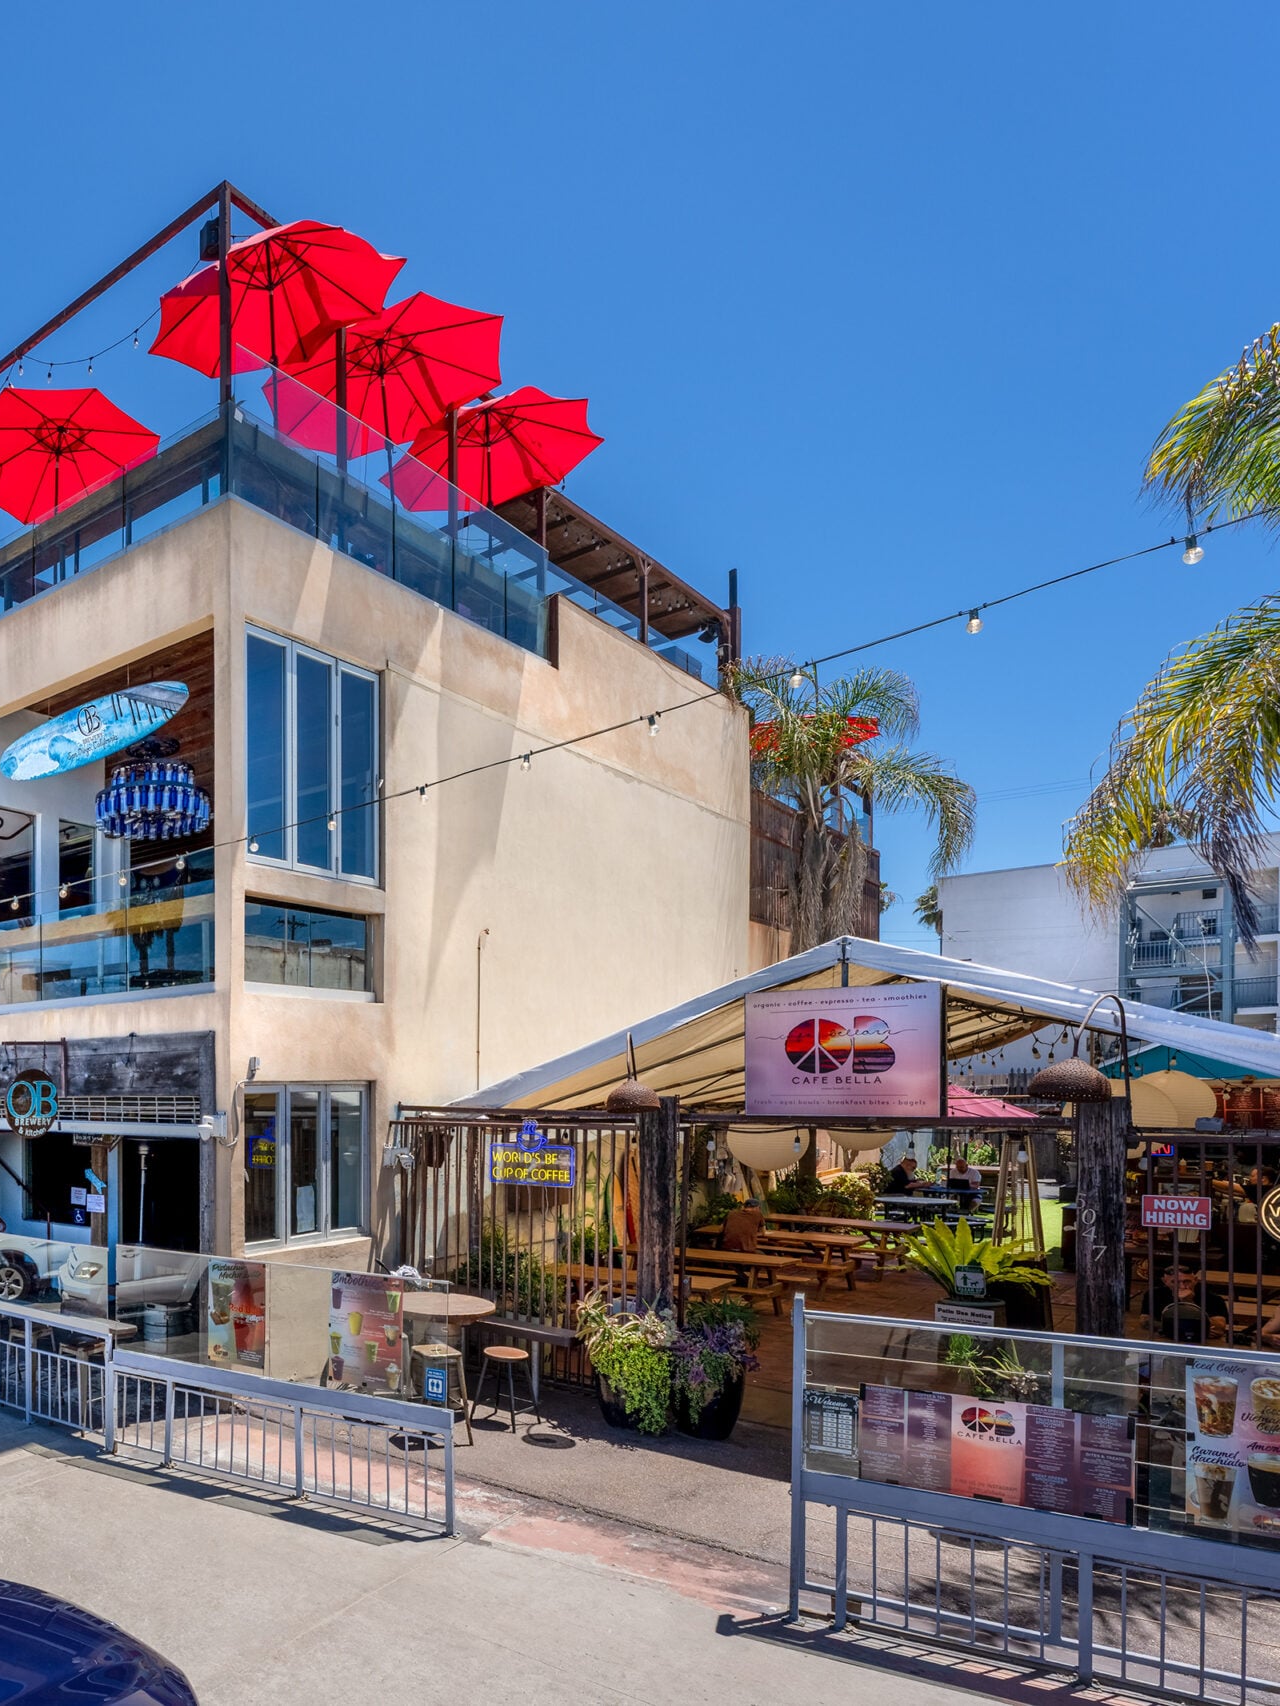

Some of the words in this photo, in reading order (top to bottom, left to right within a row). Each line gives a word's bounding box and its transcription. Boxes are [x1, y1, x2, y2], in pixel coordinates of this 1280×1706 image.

[753, 1001, 780, 1009] organic
[787, 999, 813, 1007] coffee
[820, 997, 854, 1006] espresso
[792, 1076, 829, 1085] CAFE
[835, 1075, 882, 1084] BELLA
[6, 1080, 59, 1119] OB
[898, 1099, 926, 1107] bagels
[14, 1117, 52, 1127] BREWERY
[18, 1127, 25, 1135] &
[492, 1166, 514, 1178] CUP
[514, 1167, 529, 1179] OF
[531, 1168, 571, 1182] COFFEE
[1153, 1199, 1199, 1211] NOW
[1145, 1211, 1207, 1226] HIRING
[970, 1311, 993, 1319] Notice
[1216, 1362, 1247, 1376] Coffee
[809, 1395, 849, 1408] Welcome
[957, 1430, 984, 1441] CAFE
[988, 1435, 1023, 1446] BELLA
[1191, 1444, 1240, 1460] Caramel
[1188, 1453, 1247, 1468] Macchiato
